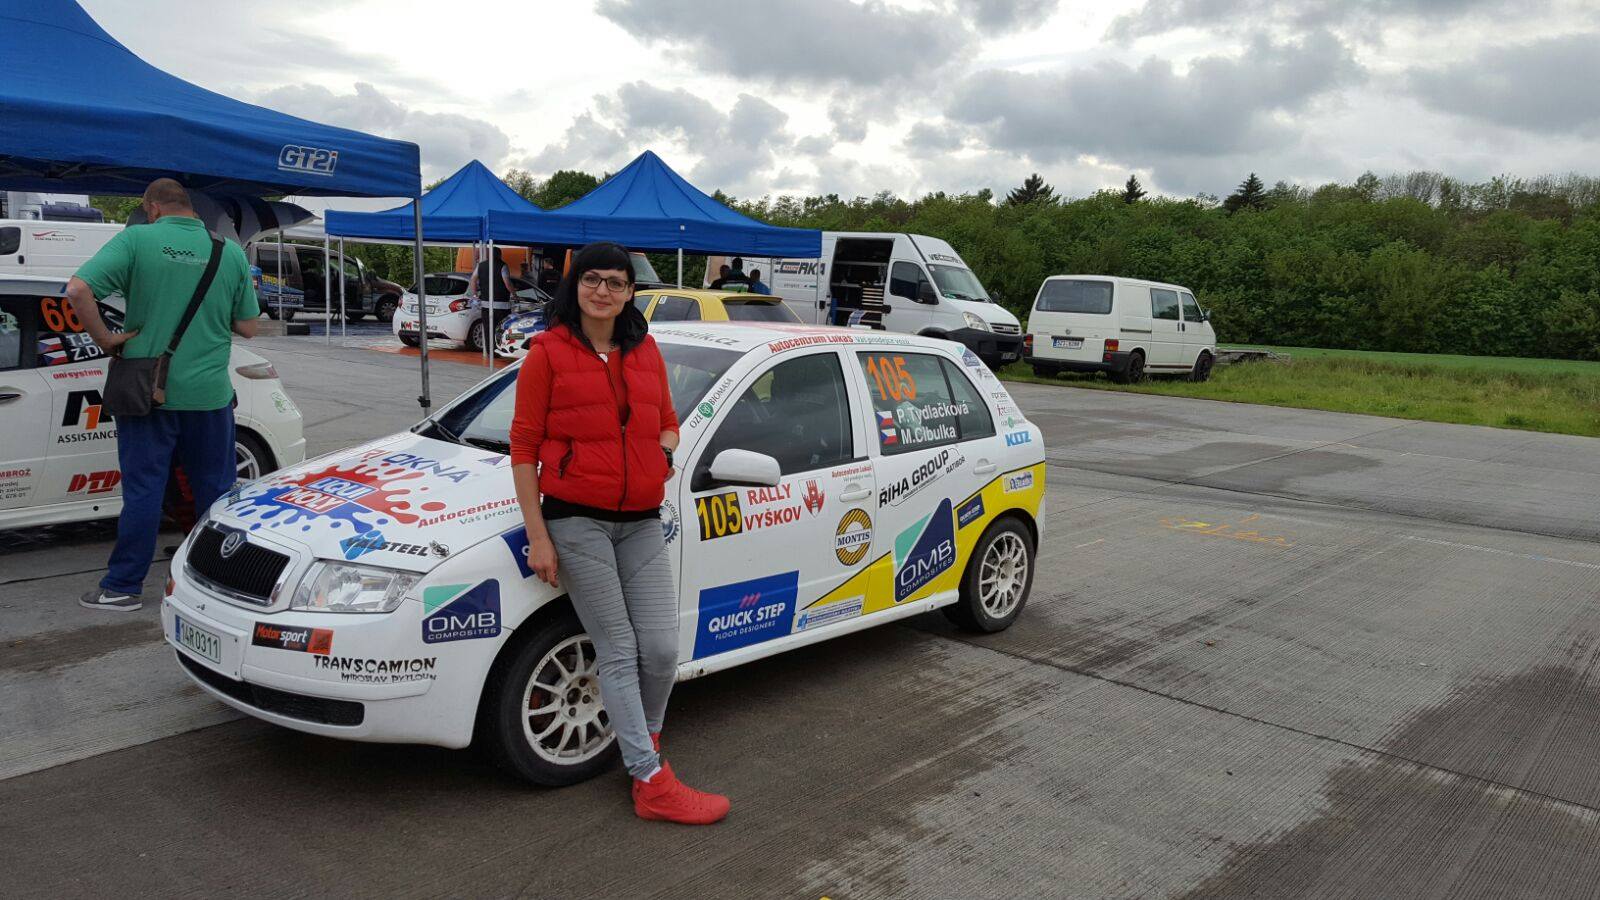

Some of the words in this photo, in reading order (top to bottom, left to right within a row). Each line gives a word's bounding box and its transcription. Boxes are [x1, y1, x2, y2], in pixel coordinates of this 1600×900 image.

[279, 144, 338, 172] GT2i
[41, 297, 85, 332] 66
[66, 332, 94, 347] T.B
[767, 334, 827, 354] Autocentrum
[866, 355, 916, 402] 105
[690, 413, 704, 428] OZE
[708, 378, 735, 406] BIOMASA
[57, 430, 119, 443] ASSISTANCE
[0, 468, 31, 478] MBROŽ
[382, 453, 471, 484] OKNA
[879, 482, 910, 508] ŘÍHA
[912, 449, 949, 486] GROUP
[946, 456, 966, 474] RATIBOR
[279, 488, 346, 511] MOLY
[306, 477, 374, 499] LIQUI
[747, 483, 791, 505] RALLY
[484, 506, 520, 520] prode
[664, 499, 680, 523] Group
[696, 495, 743, 539] 105
[744, 505, 802, 531] VYŠKOV
[837, 531, 871, 546] MONTIS
[901, 539, 952, 586] OMB
[901, 556, 953, 596] COMPOSITES
[428, 612, 496, 633] OMB
[708, 609, 754, 633] QUICK
[756, 602, 786, 622] STEP
[255, 624, 308, 647] Motorsport
[427, 627, 497, 641] COMPOSITES
[715, 630, 738, 641] FLOOR
[739, 620, 776, 635] DESIGNERS
[313, 654, 438, 674] TRANSCAMION
[341, 672, 388, 683] MIROSLAV
[391, 672, 437, 683] PYTLOUN
